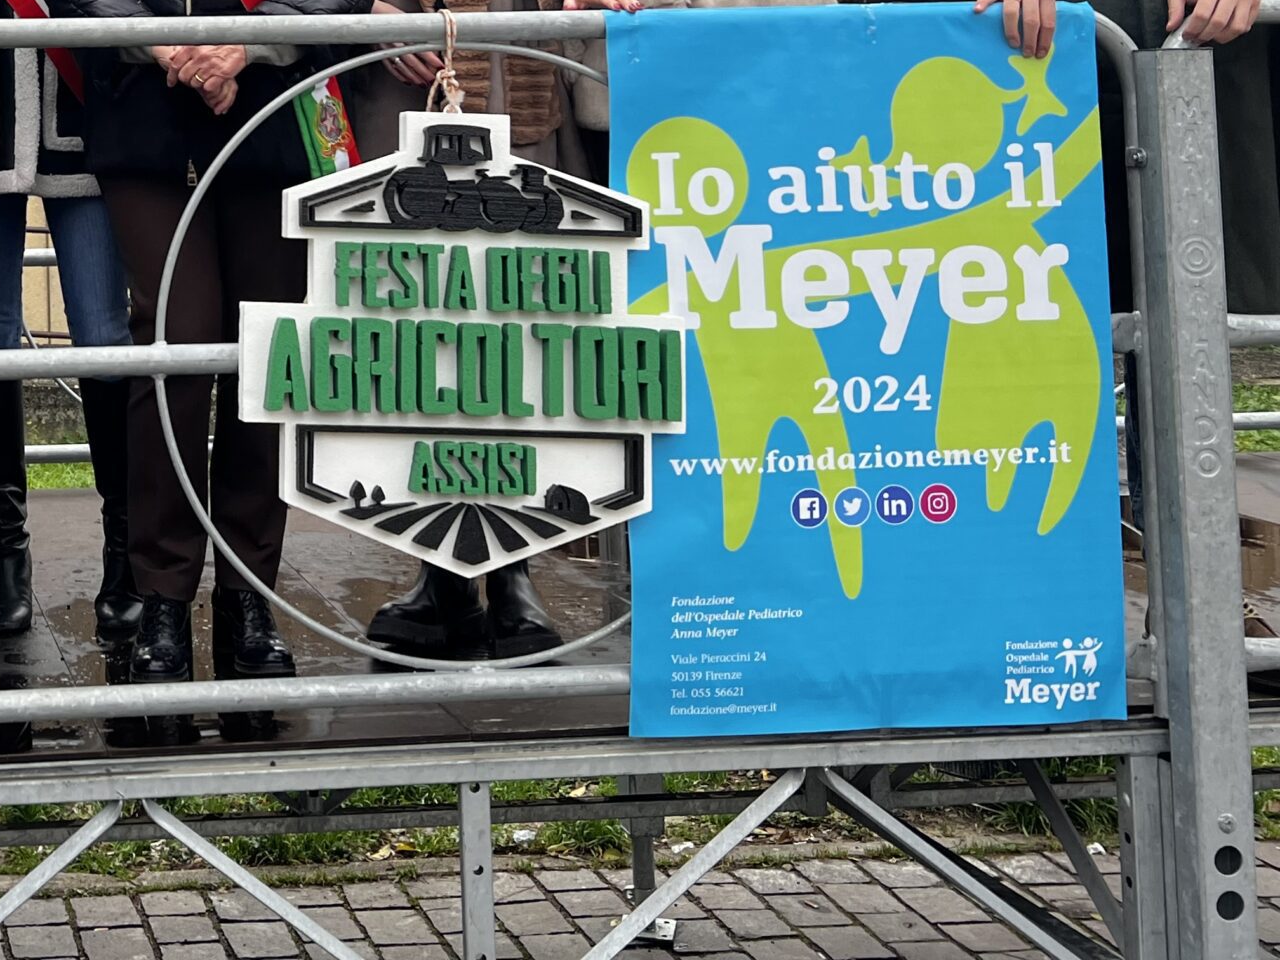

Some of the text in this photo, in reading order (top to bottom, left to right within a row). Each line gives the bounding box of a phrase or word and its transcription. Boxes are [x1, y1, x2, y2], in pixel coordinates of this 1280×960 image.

[650, 141, 1063, 216] Io aiuto il
[334, 240, 613, 315] FESTA DEGLI
[654, 223, 1070, 355] Meyer
[262, 316, 683, 422] AGRICOLTORI
[812, 373, 933, 415] 2024
[669, 439, 1072, 477] www.fondazionemeyer.it
[407, 440, 538, 497] ASSISI
[671, 595, 735, 607] Fondazione
[671, 606, 803, 624] dell'Ospedale Pediatrico
[671, 623, 738, 640] Anna Meyer
[1006, 639, 1058, 650] Fondazione
[671, 651, 766, 664] Viale Pieraccini 24
[1006, 653, 1049, 664] Ospedale
[671, 669, 742, 682] 50139 Firenze
[1006, 665, 1054, 675] Pediatrico
[671, 686, 744, 699] Tel. 055 56621
[1004, 678, 1100, 710] Meyer
[670, 702, 777, 718] fondazione@meyer.it
